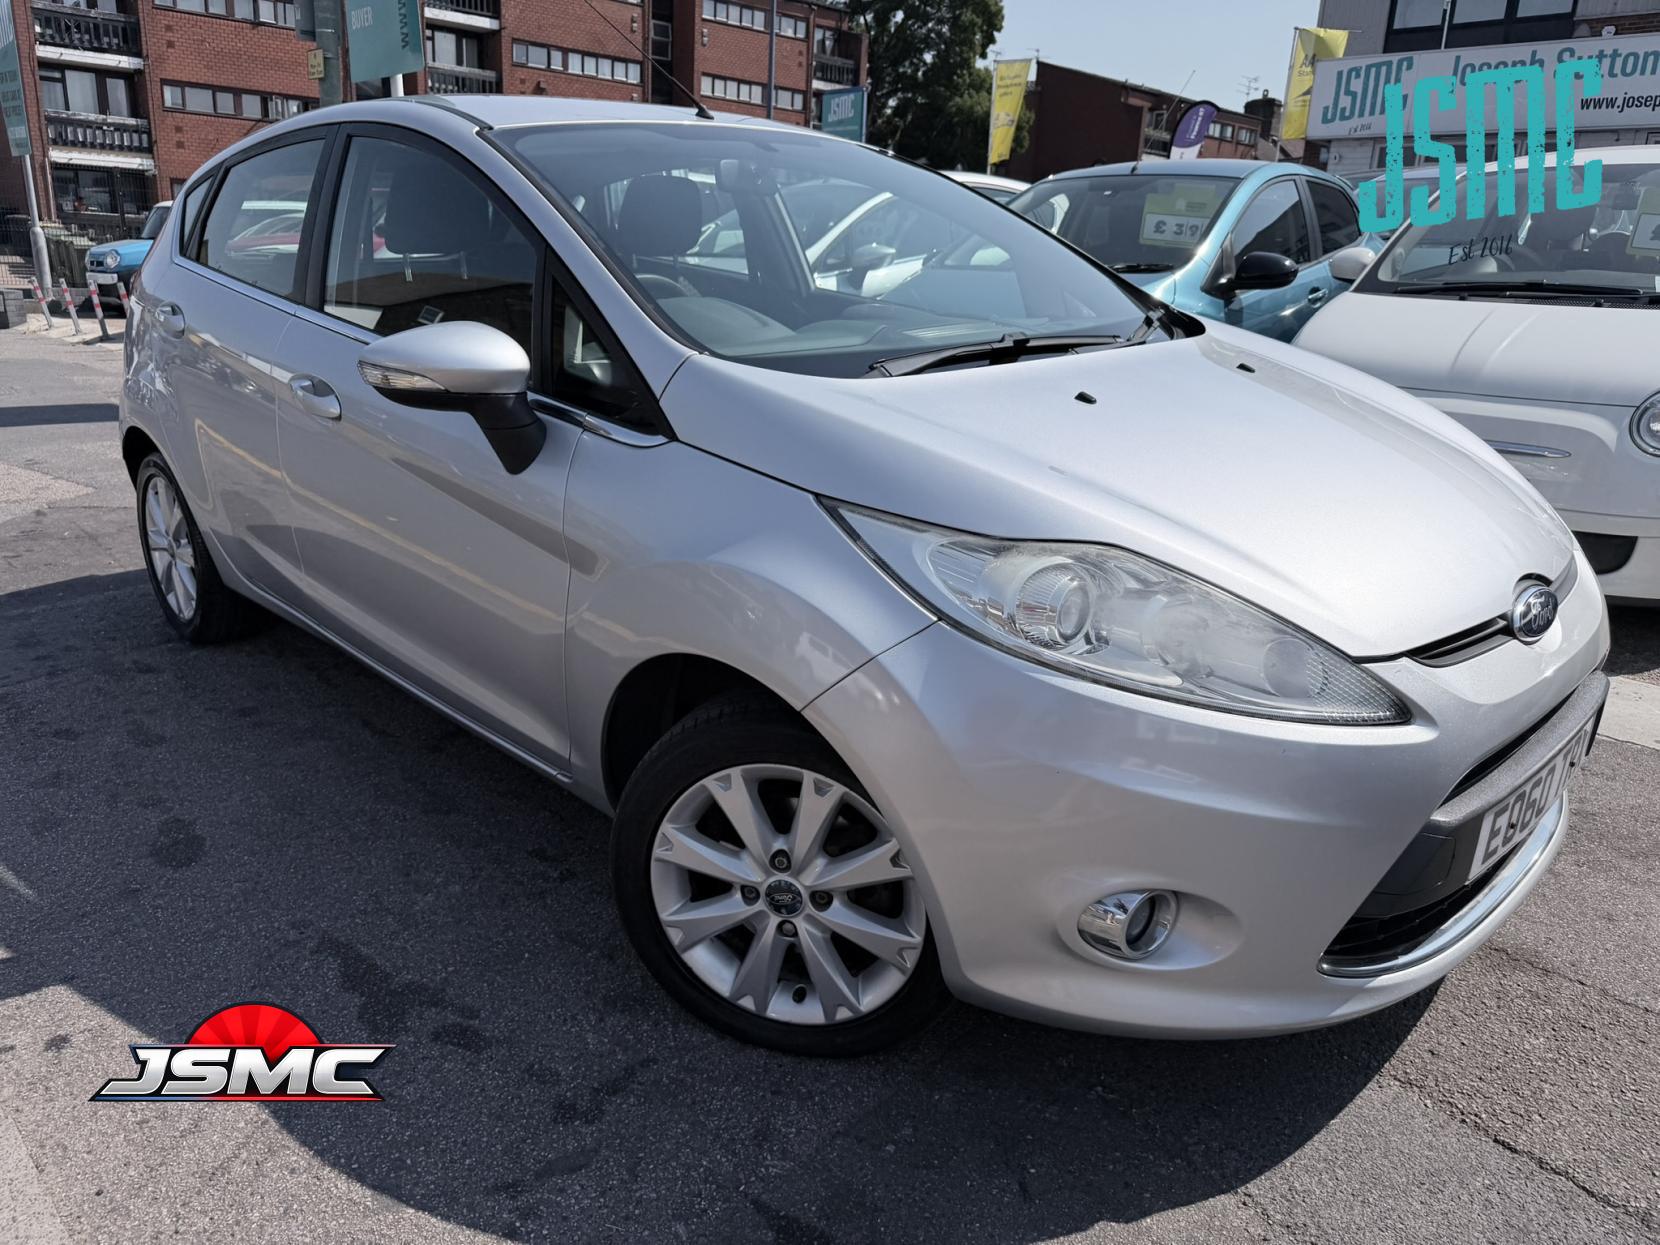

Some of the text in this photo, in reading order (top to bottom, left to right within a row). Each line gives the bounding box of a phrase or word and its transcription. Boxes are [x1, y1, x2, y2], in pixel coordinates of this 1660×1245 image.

[351, 6, 374, 30] BUYER
[1321, 56, 1414, 124] JSMC
[828, 93, 855, 122] JSMC
[1521, 594, 1553, 630] Ford
